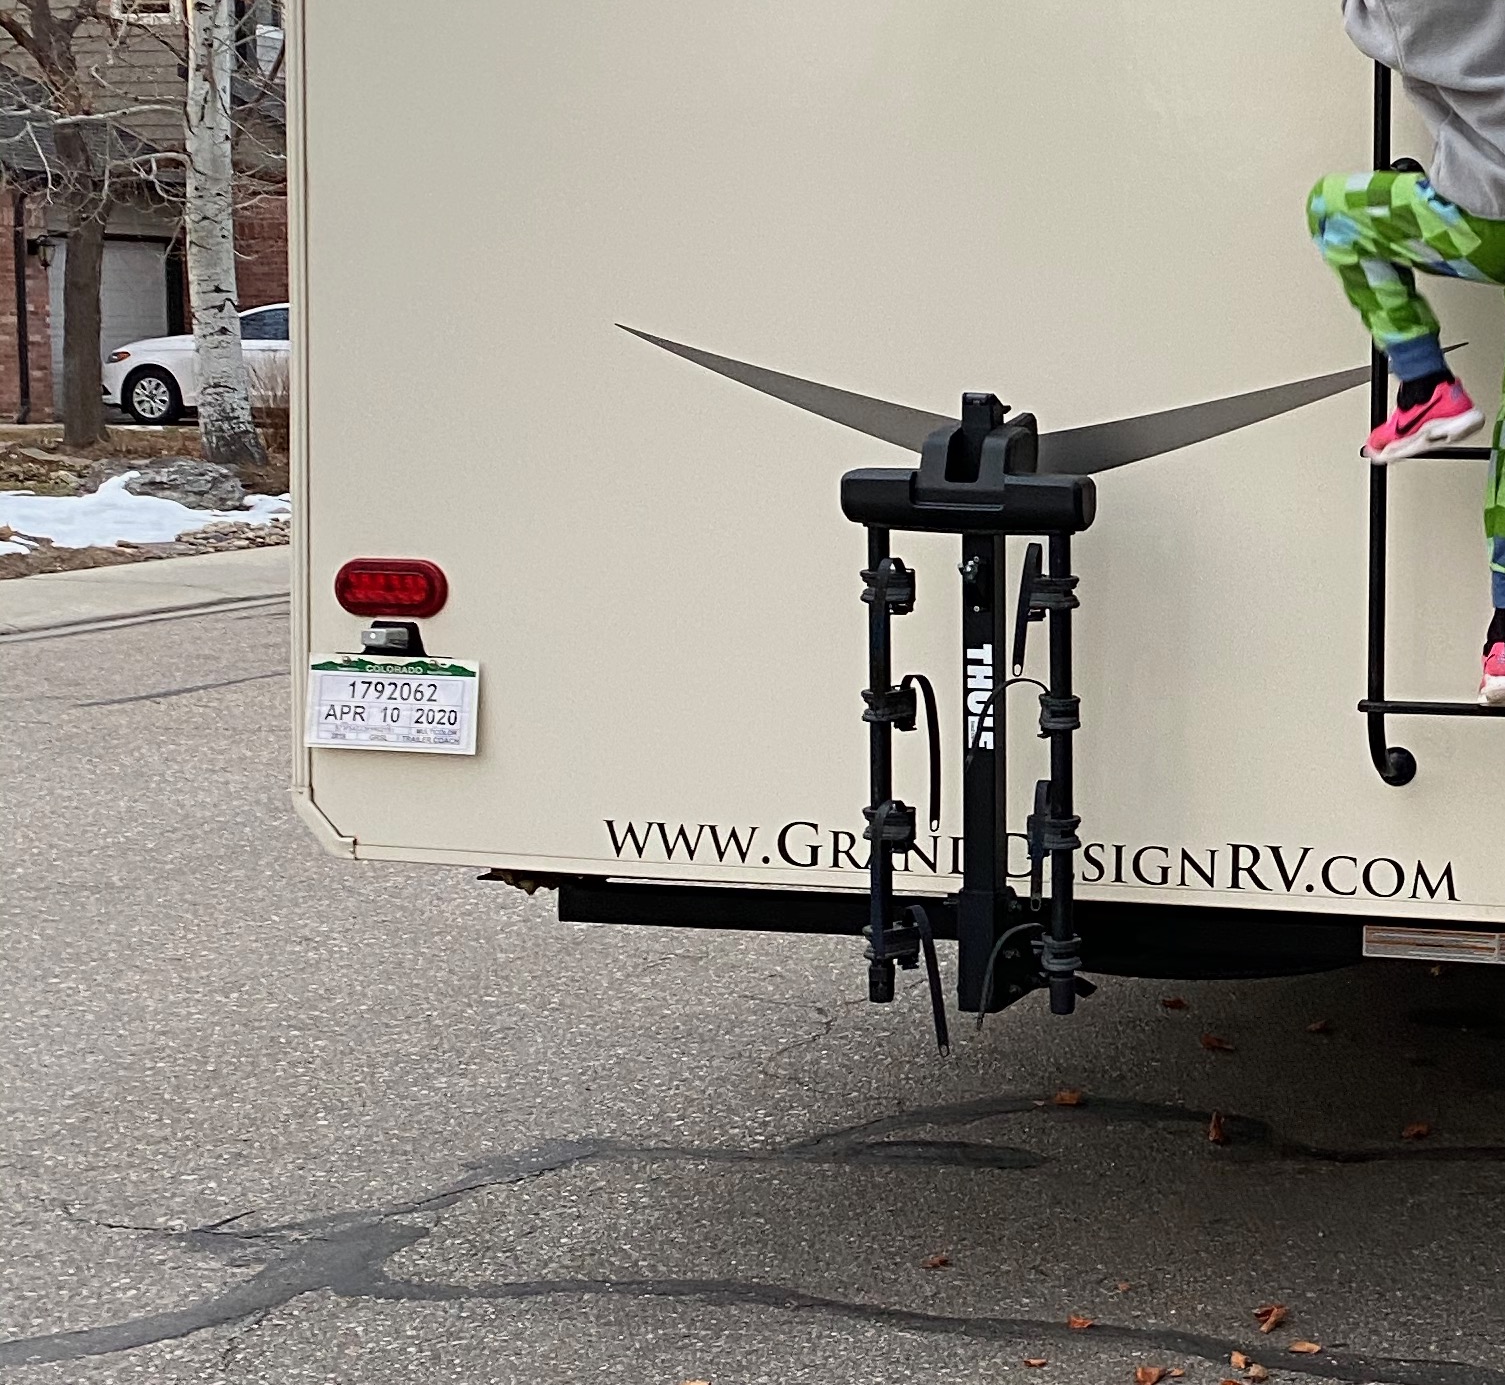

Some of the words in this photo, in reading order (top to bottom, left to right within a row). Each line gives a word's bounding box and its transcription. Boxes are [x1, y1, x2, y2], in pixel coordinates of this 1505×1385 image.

[365, 664, 424, 676] COLORADO
[348, 680, 438, 703] 1792062
[966, 643, 994, 749] THULE
[324, 704, 366, 722] APR
[381, 706, 400, 724] 10
[414, 708, 458, 726] 2020
